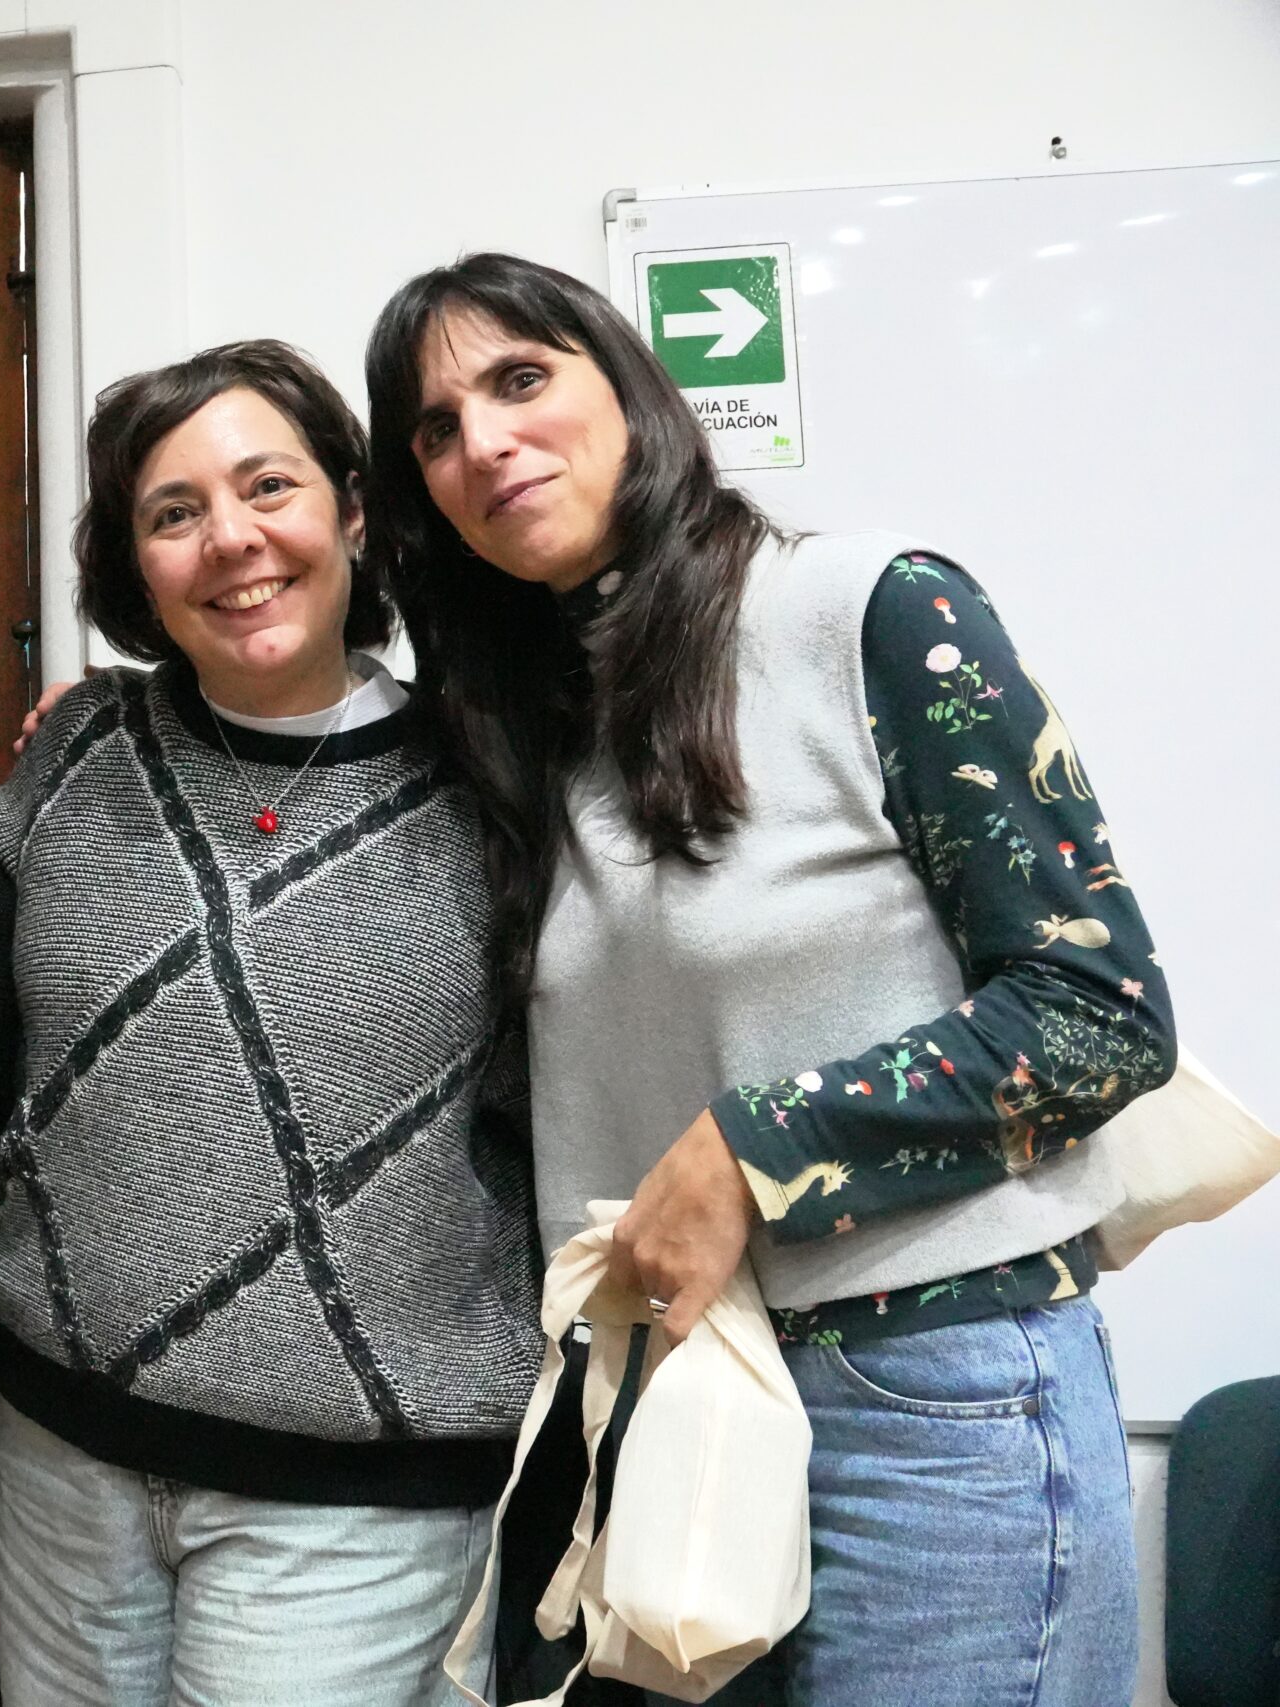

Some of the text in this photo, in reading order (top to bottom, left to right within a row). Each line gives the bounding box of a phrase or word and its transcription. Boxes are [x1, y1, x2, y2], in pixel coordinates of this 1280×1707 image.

[693, 398, 750, 414] VÍA DE
[701, 412, 777, 431] CUACIÓN
